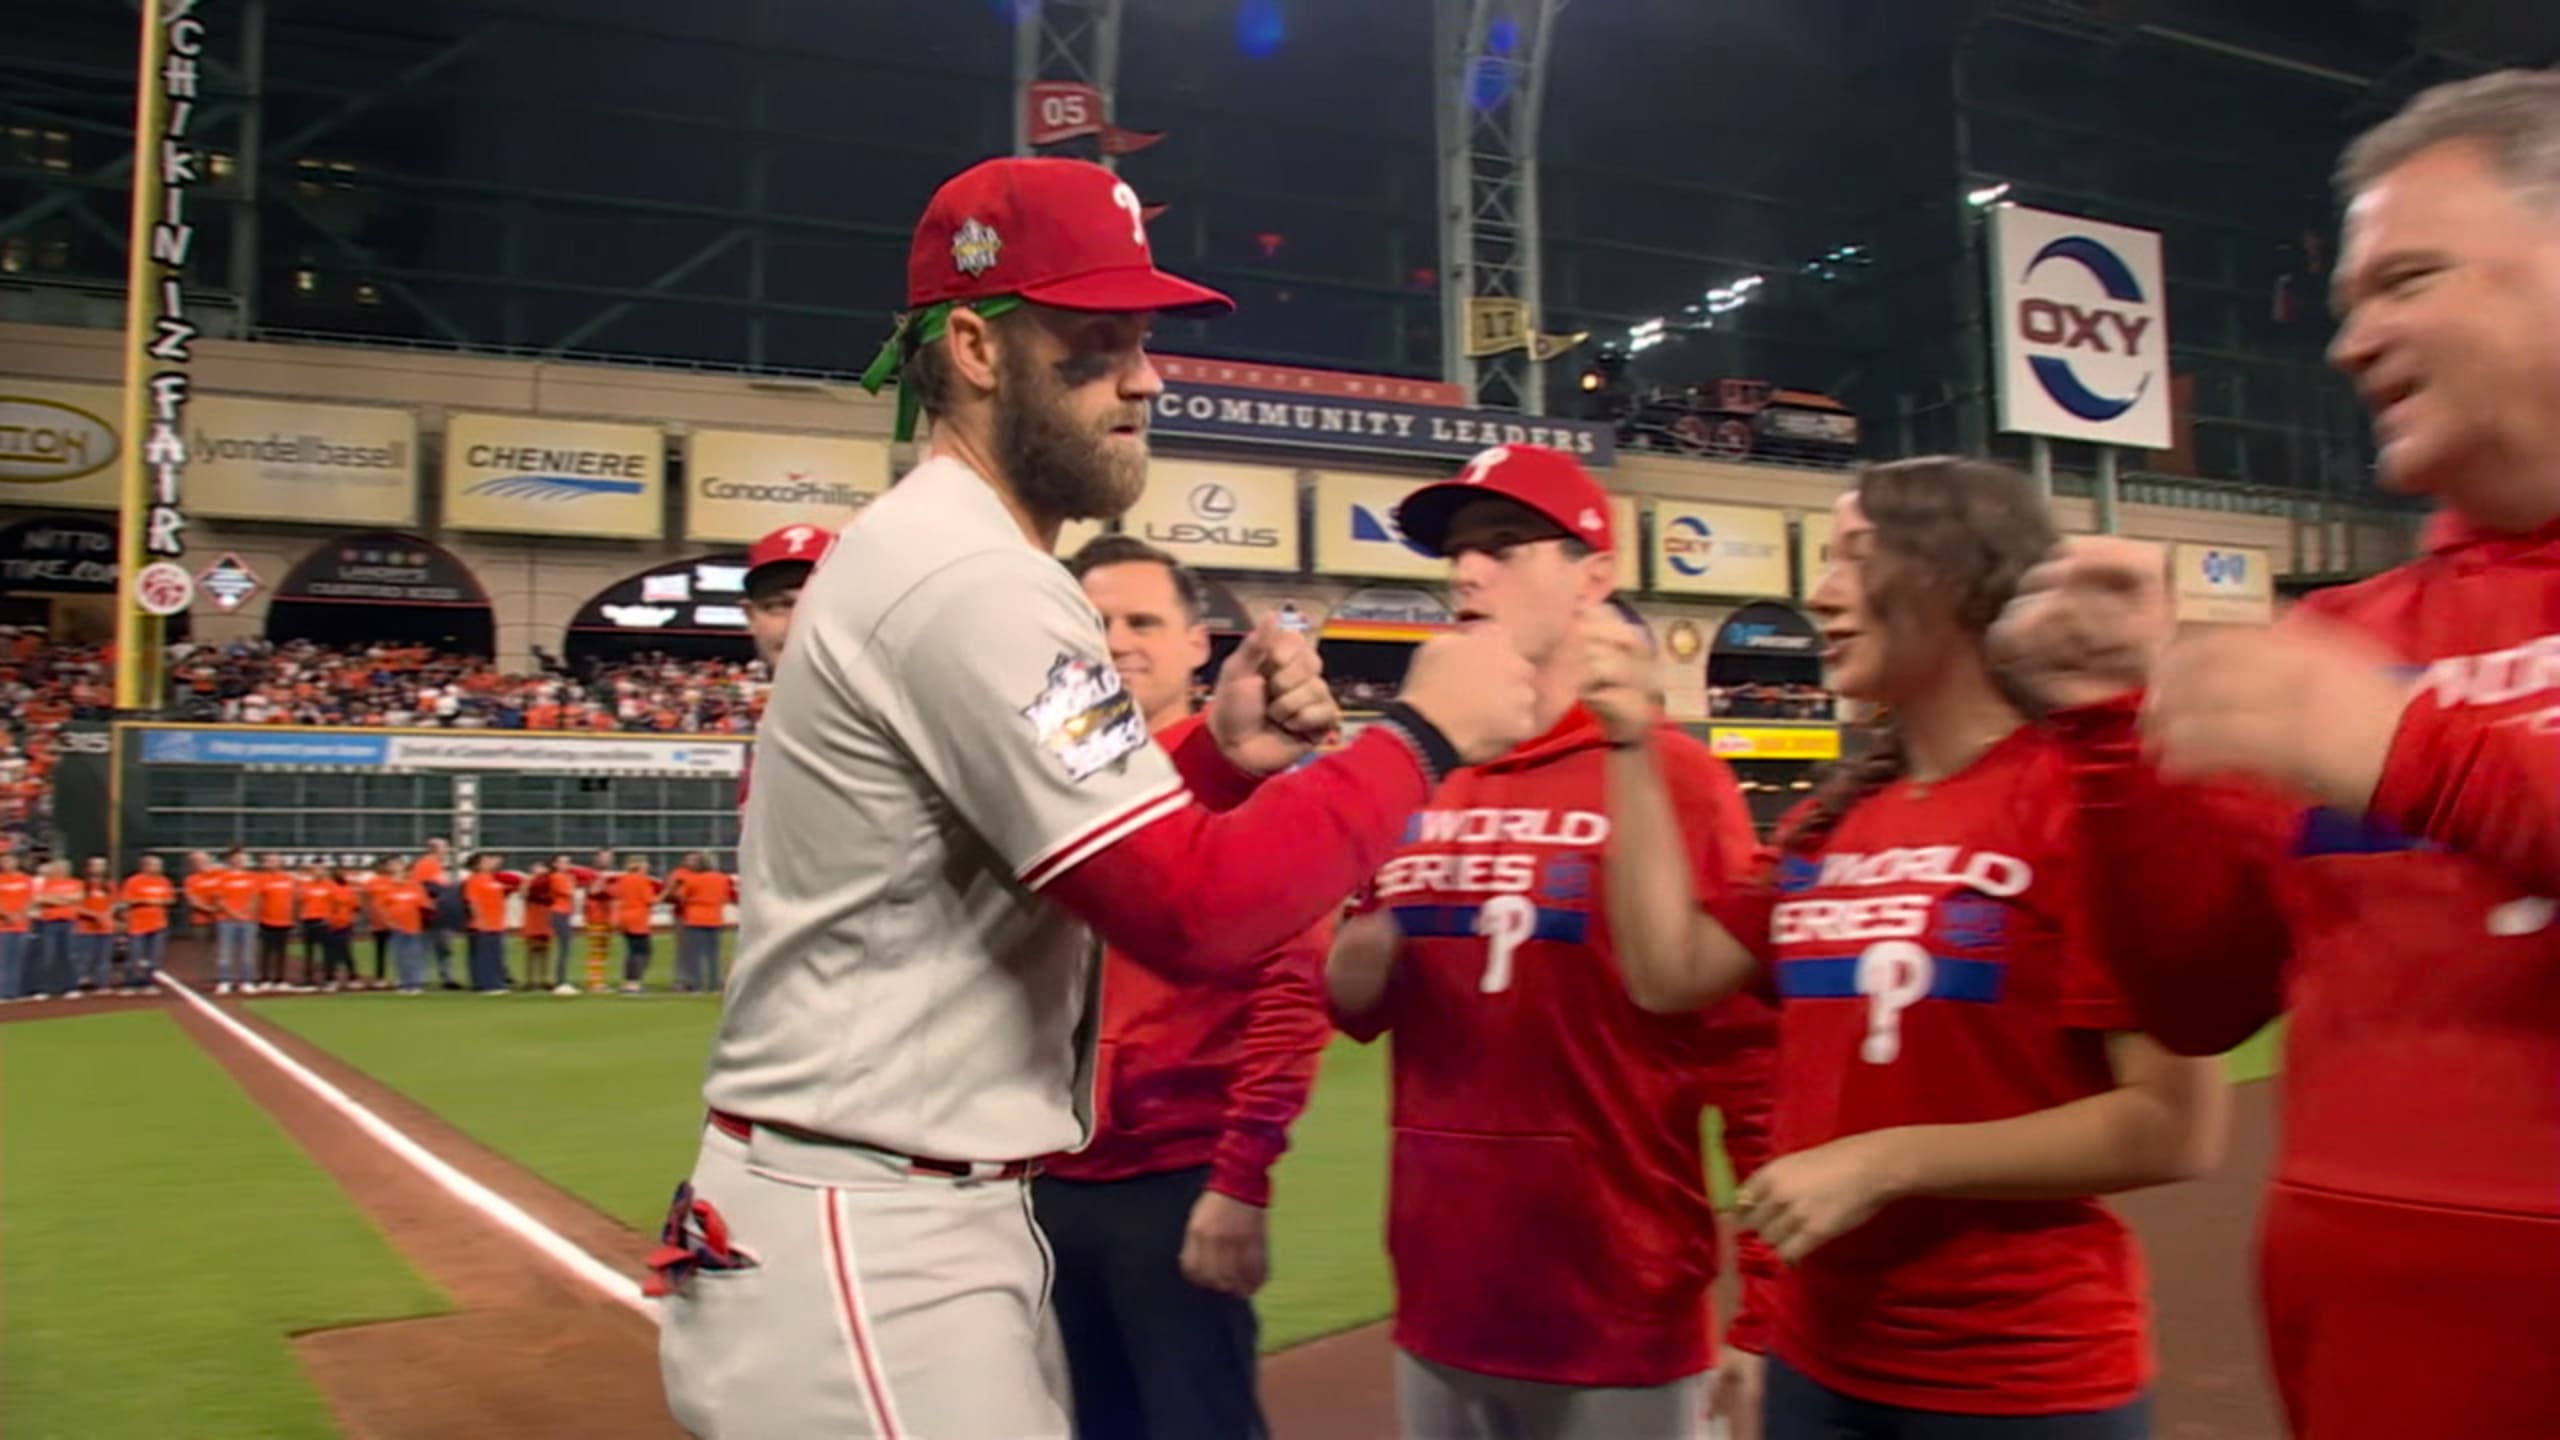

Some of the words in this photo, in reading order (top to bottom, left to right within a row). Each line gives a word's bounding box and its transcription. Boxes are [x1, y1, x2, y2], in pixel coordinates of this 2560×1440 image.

[1042, 95, 1087, 127] 05
[1481, 310, 1516, 340] 17
[2018, 297, 2153, 357] OXY
[1157, 393, 1415, 438] COMMUNITY
[1431, 417, 1596, 455] LEADERS
[145, 375, 188, 553] FAIR
[465, 443, 649, 479] CHENIERE
[700, 476, 877, 510] ConocoPhillip
[1146, 522, 1279, 549] LEXUS
[1419, 807, 1611, 846] WORLD
[1818, 845, 2033, 896] WORLD
[1770, 894, 1933, 944] ERIES
[1853, 939, 1936, 1065] P
